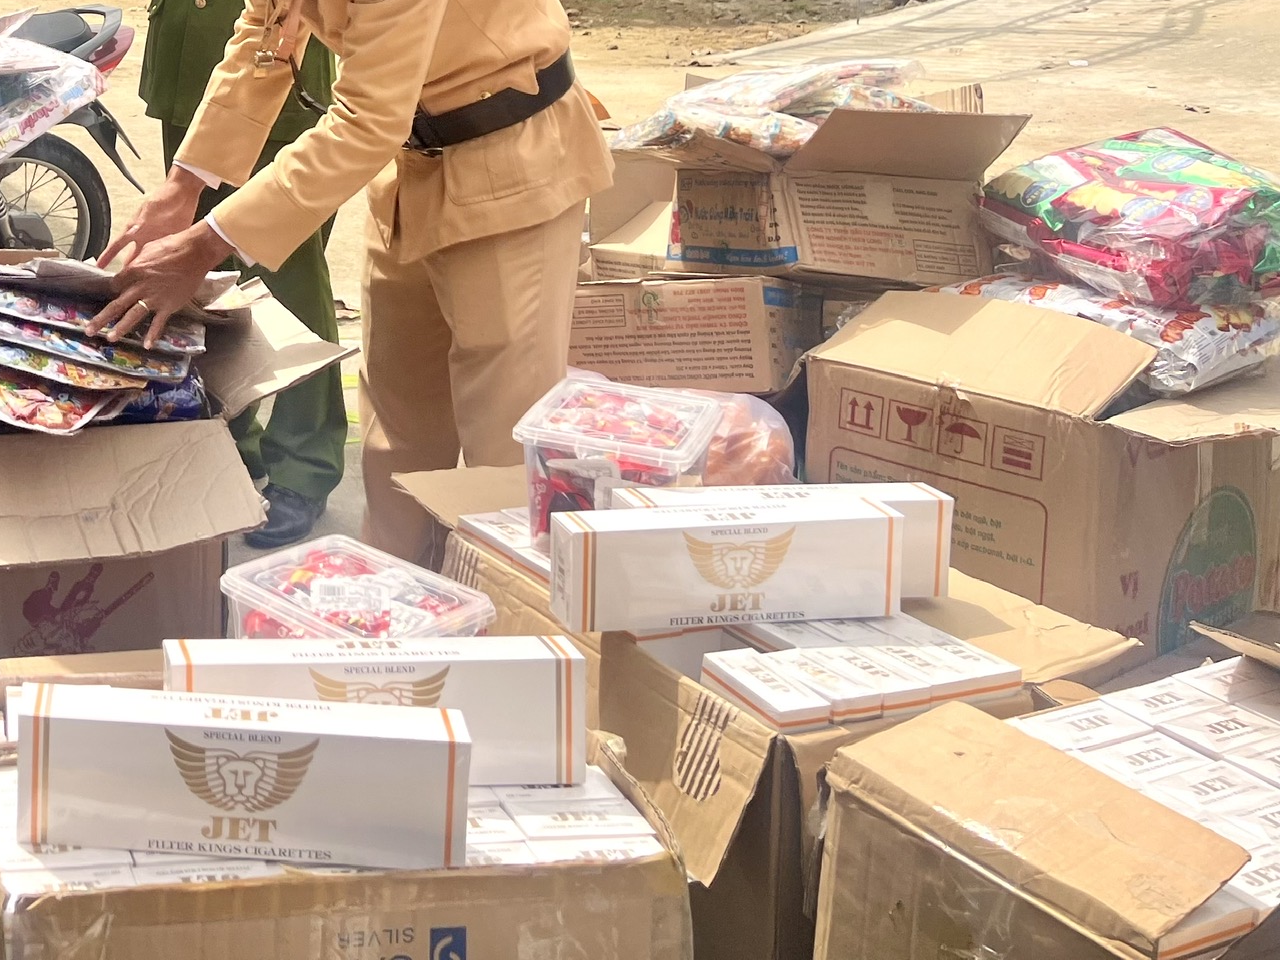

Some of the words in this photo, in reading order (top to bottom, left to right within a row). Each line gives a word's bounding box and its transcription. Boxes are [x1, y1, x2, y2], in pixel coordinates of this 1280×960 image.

[710, 528, 743, 537] SPECIAL
[744, 527, 768, 535] BLEND
[709, 592, 767, 612] JET
[670, 616, 704, 626] FILTER
[707, 614, 739, 624] KINGS
[741, 611, 805, 622] CIGARETTES
[344, 665, 383, 675] SPECIAL
[385, 665, 416, 674] BLEND
[1140, 691, 1186, 709] JET
[1066, 713, 1114, 732] JET
[1205, 717, 1251, 735] JET
[203, 730, 245, 742] SPECIAL
[248, 732, 282, 744] BLEND
[1125, 747, 1172, 767] JET
[1189, 775, 1238, 797] JET
[551, 810, 609, 822] JET
[201, 816, 277, 843] JET
[148, 840, 193, 852] FILTER
[197, 842, 242, 854] KINGS
[244, 846, 332, 860] CIGARETTES
[337, 927, 415, 950] SILVER
